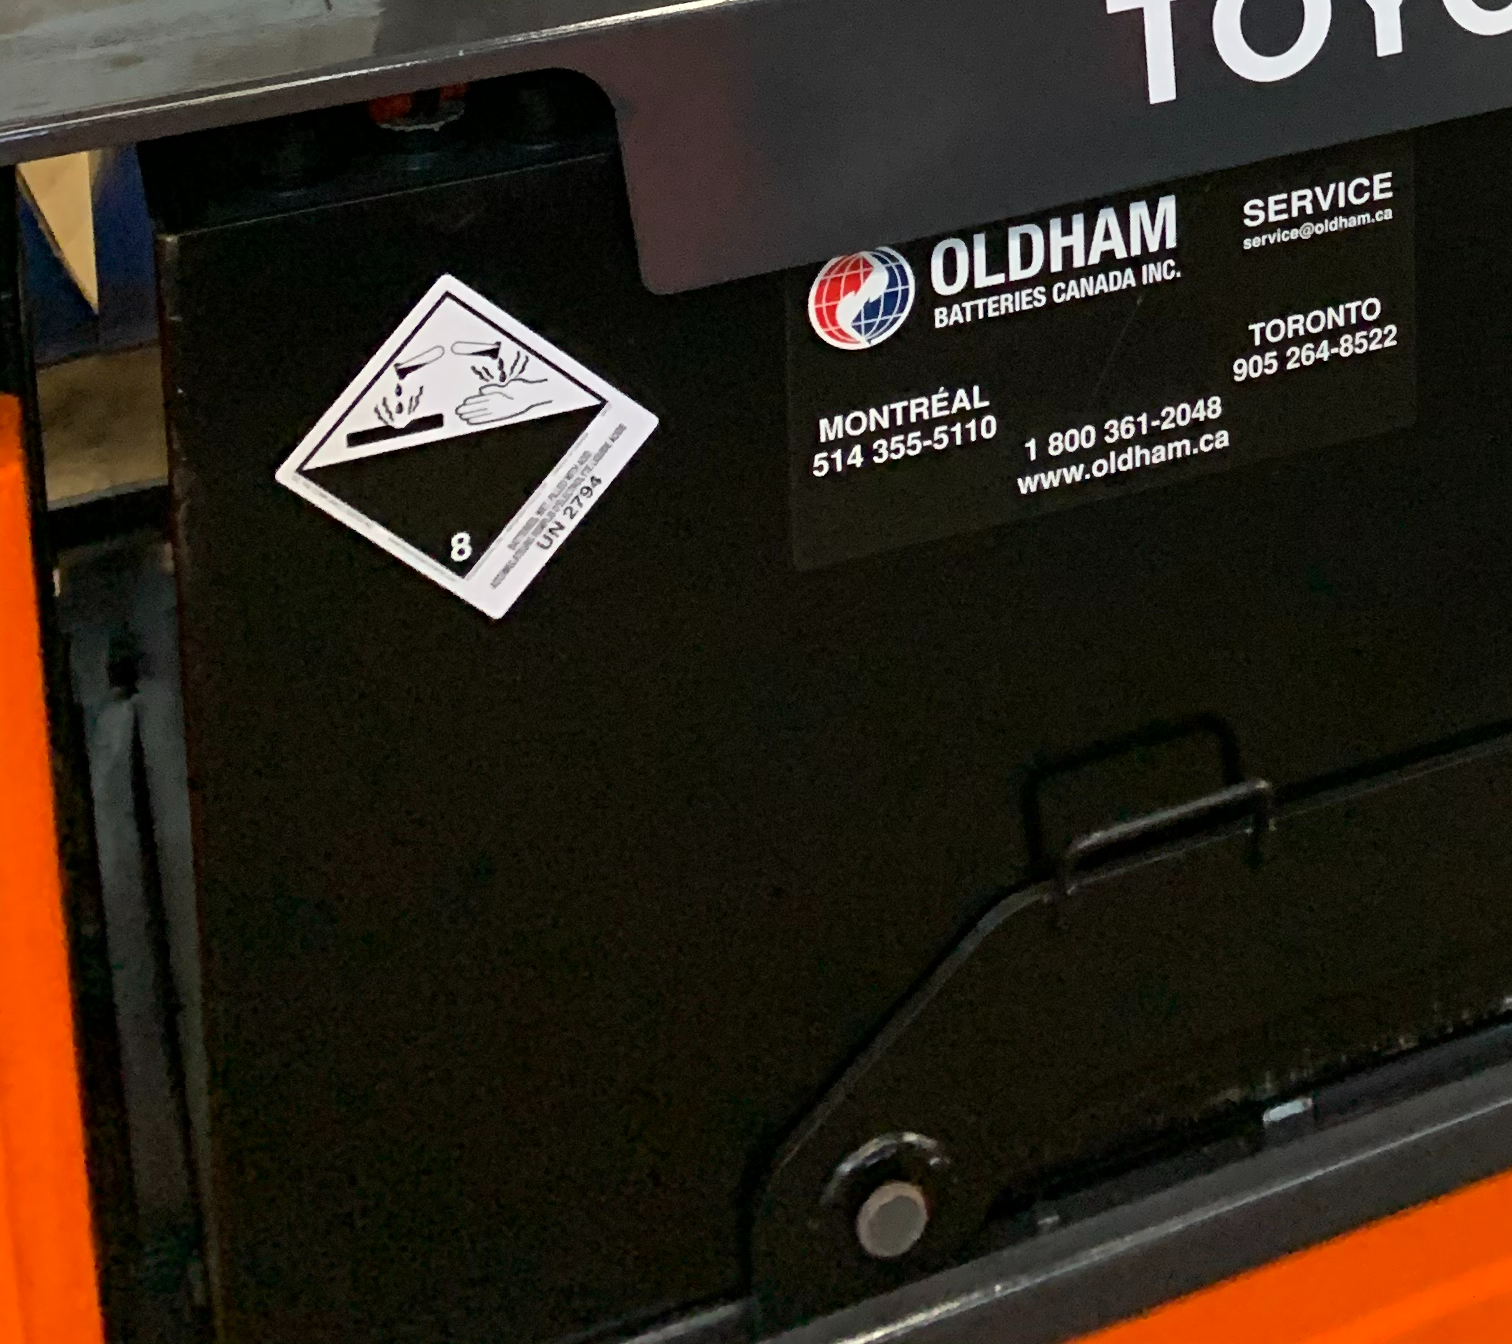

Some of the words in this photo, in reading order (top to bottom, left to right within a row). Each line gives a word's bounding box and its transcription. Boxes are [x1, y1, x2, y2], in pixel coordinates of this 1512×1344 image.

[1242, 208, 1394, 250] service@oldham.ca
[1243, 171, 1394, 228] SERVICE
[930, 195, 1179, 297] OLDHAM
[934, 285, 1047, 329] BATTERIES
[1052, 267, 1137, 305] CANADA
[1141, 258, 1182, 287] INC.
[1248, 297, 1382, 347] TORONTO
[1232, 350, 1278, 382] 905
[1285, 324, 1398, 371] 264-8522
[818, 384, 990, 444] MONTRÉAL
[1024, 437, 1038, 462] 1
[1048, 424, 1097, 458] 800
[1103, 395, 1223, 444] 361-2048
[812, 444, 865, 478] 514
[872, 414, 997, 465] 355-5110
[1017, 426, 1231, 496] www.oldham.ca
[535, 521, 566, 551] UN
[562, 475, 603, 521] 2794
[450, 531, 473, 563] 8
